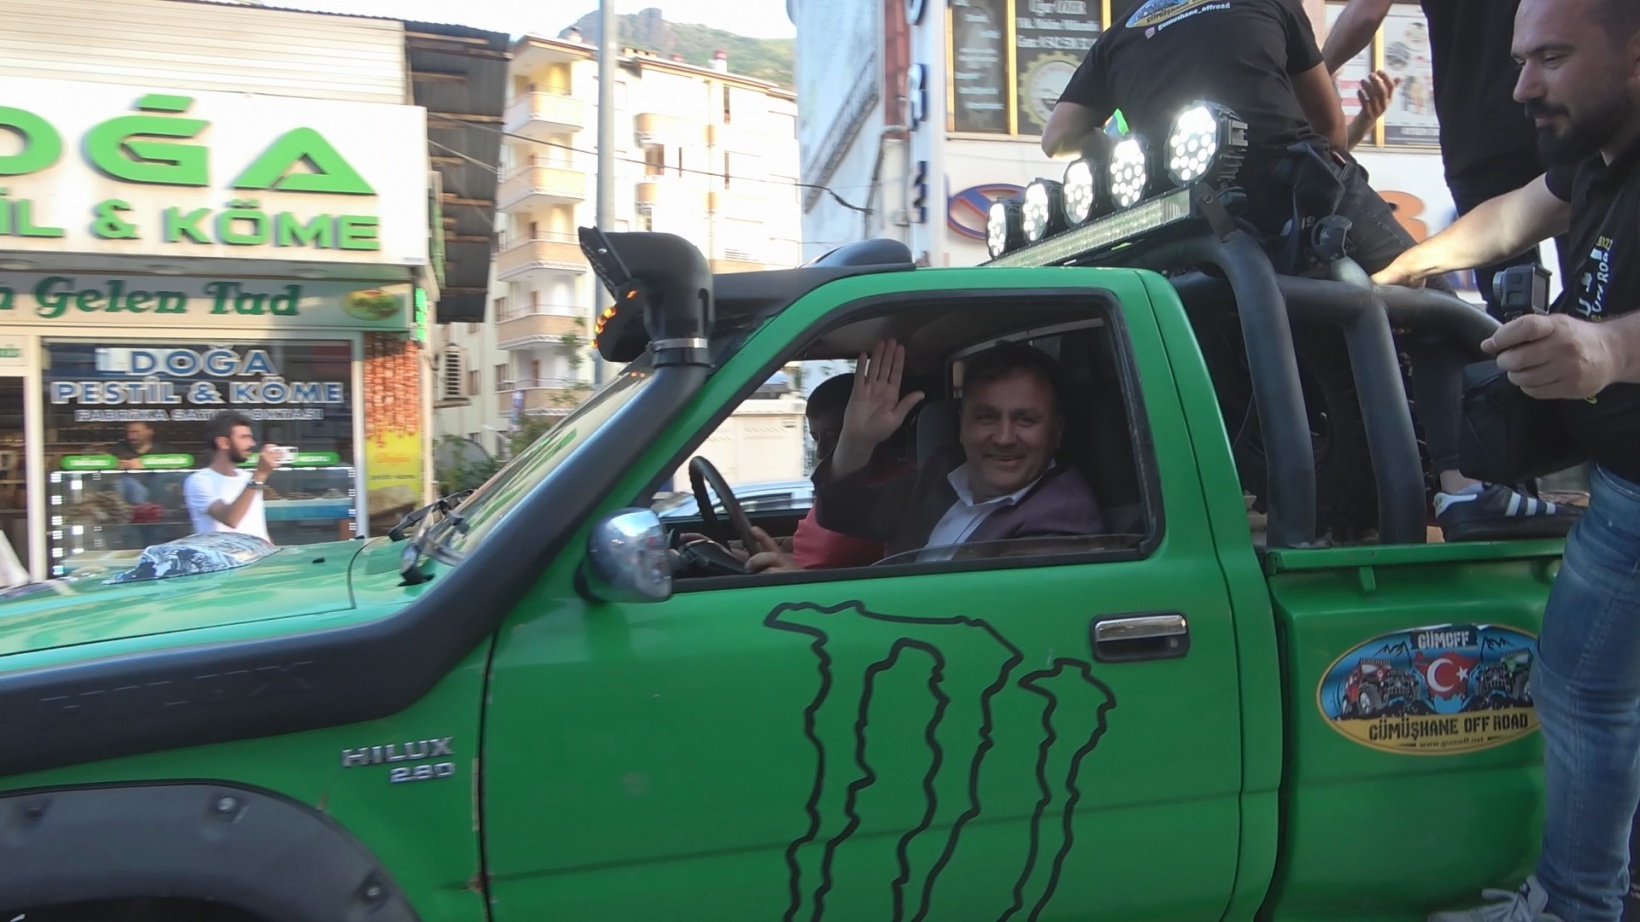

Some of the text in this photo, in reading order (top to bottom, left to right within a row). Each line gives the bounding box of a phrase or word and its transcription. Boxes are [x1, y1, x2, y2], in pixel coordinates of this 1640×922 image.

[90, 199, 141, 240] &
[160, 200, 381, 251] KÖME
[34, 276, 188, 319] Gelen
[203, 281, 305, 316] Tad
[126, 344, 278, 377] DOĞA
[50, 376, 345, 405] PESTİL & KÖME
[73, 408, 169, 422] FABRİKA
[1417, 631, 1470, 648] GÜMOFF
[1368, 712, 1529, 742] GÜMÜŞHANE OFF ROAD
[342, 736, 454, 767] HILUX
